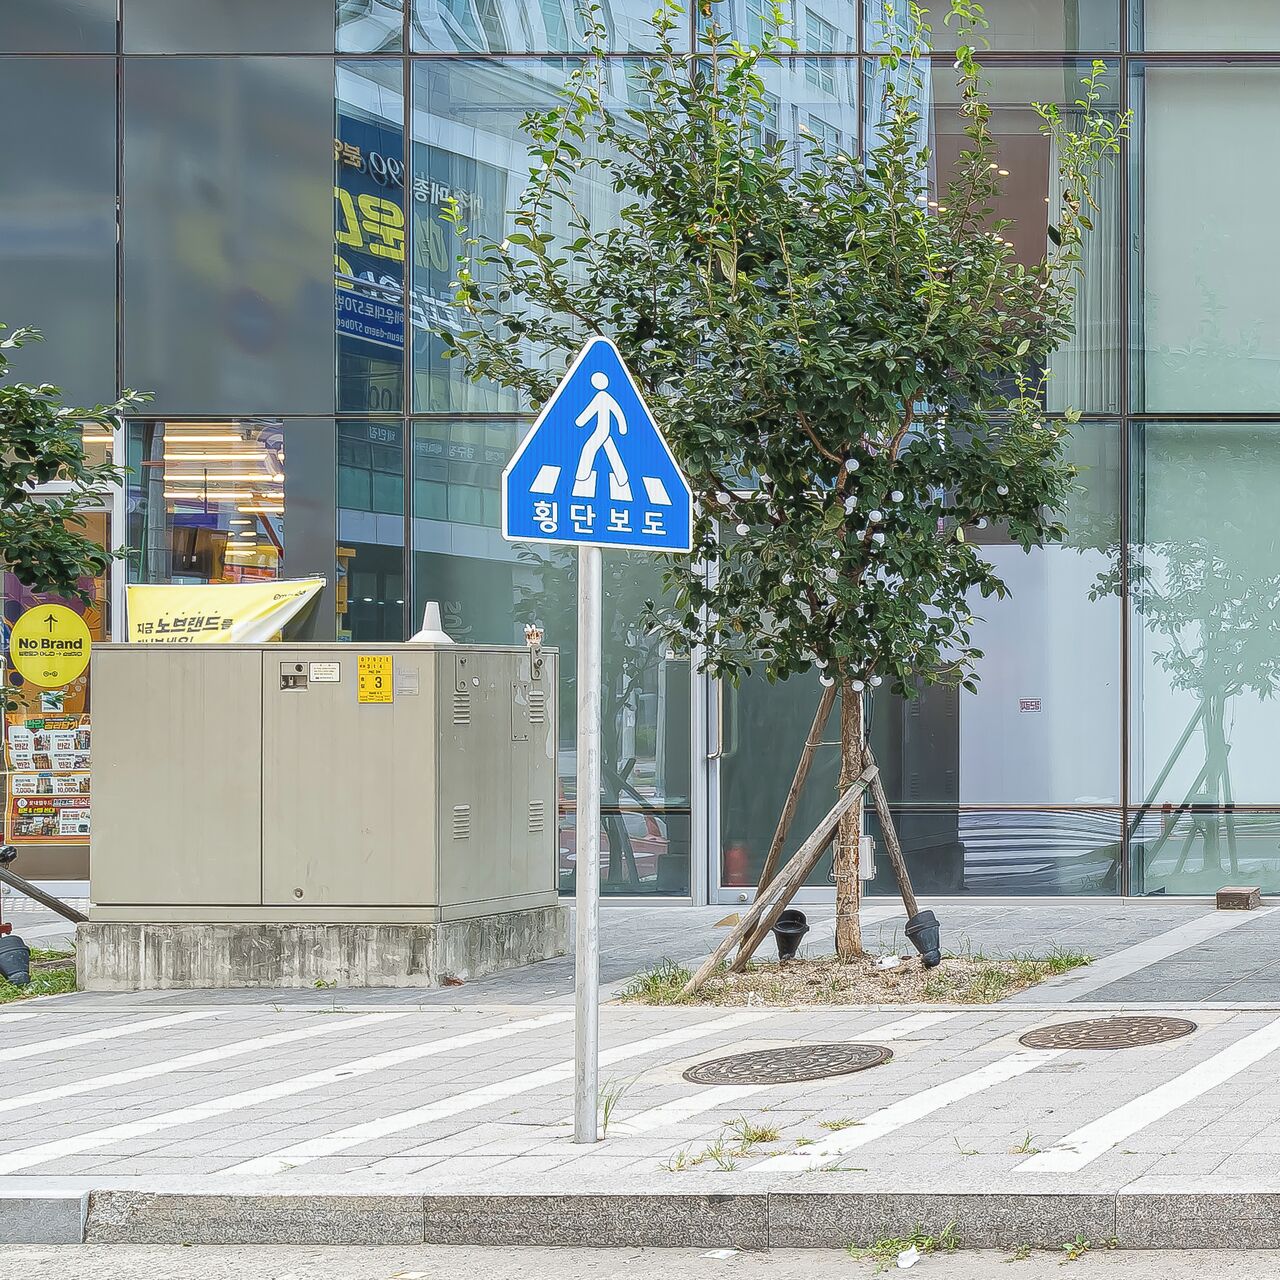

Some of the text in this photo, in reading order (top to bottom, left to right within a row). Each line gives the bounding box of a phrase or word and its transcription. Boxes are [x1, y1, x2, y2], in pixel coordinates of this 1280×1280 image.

[532, 500, 668, 536] 횡단보도
[137, 616, 233, 635] 지금 노브랜드를
[19, 638, 82, 649] No Brand
[375, 676, 383, 689] 3
